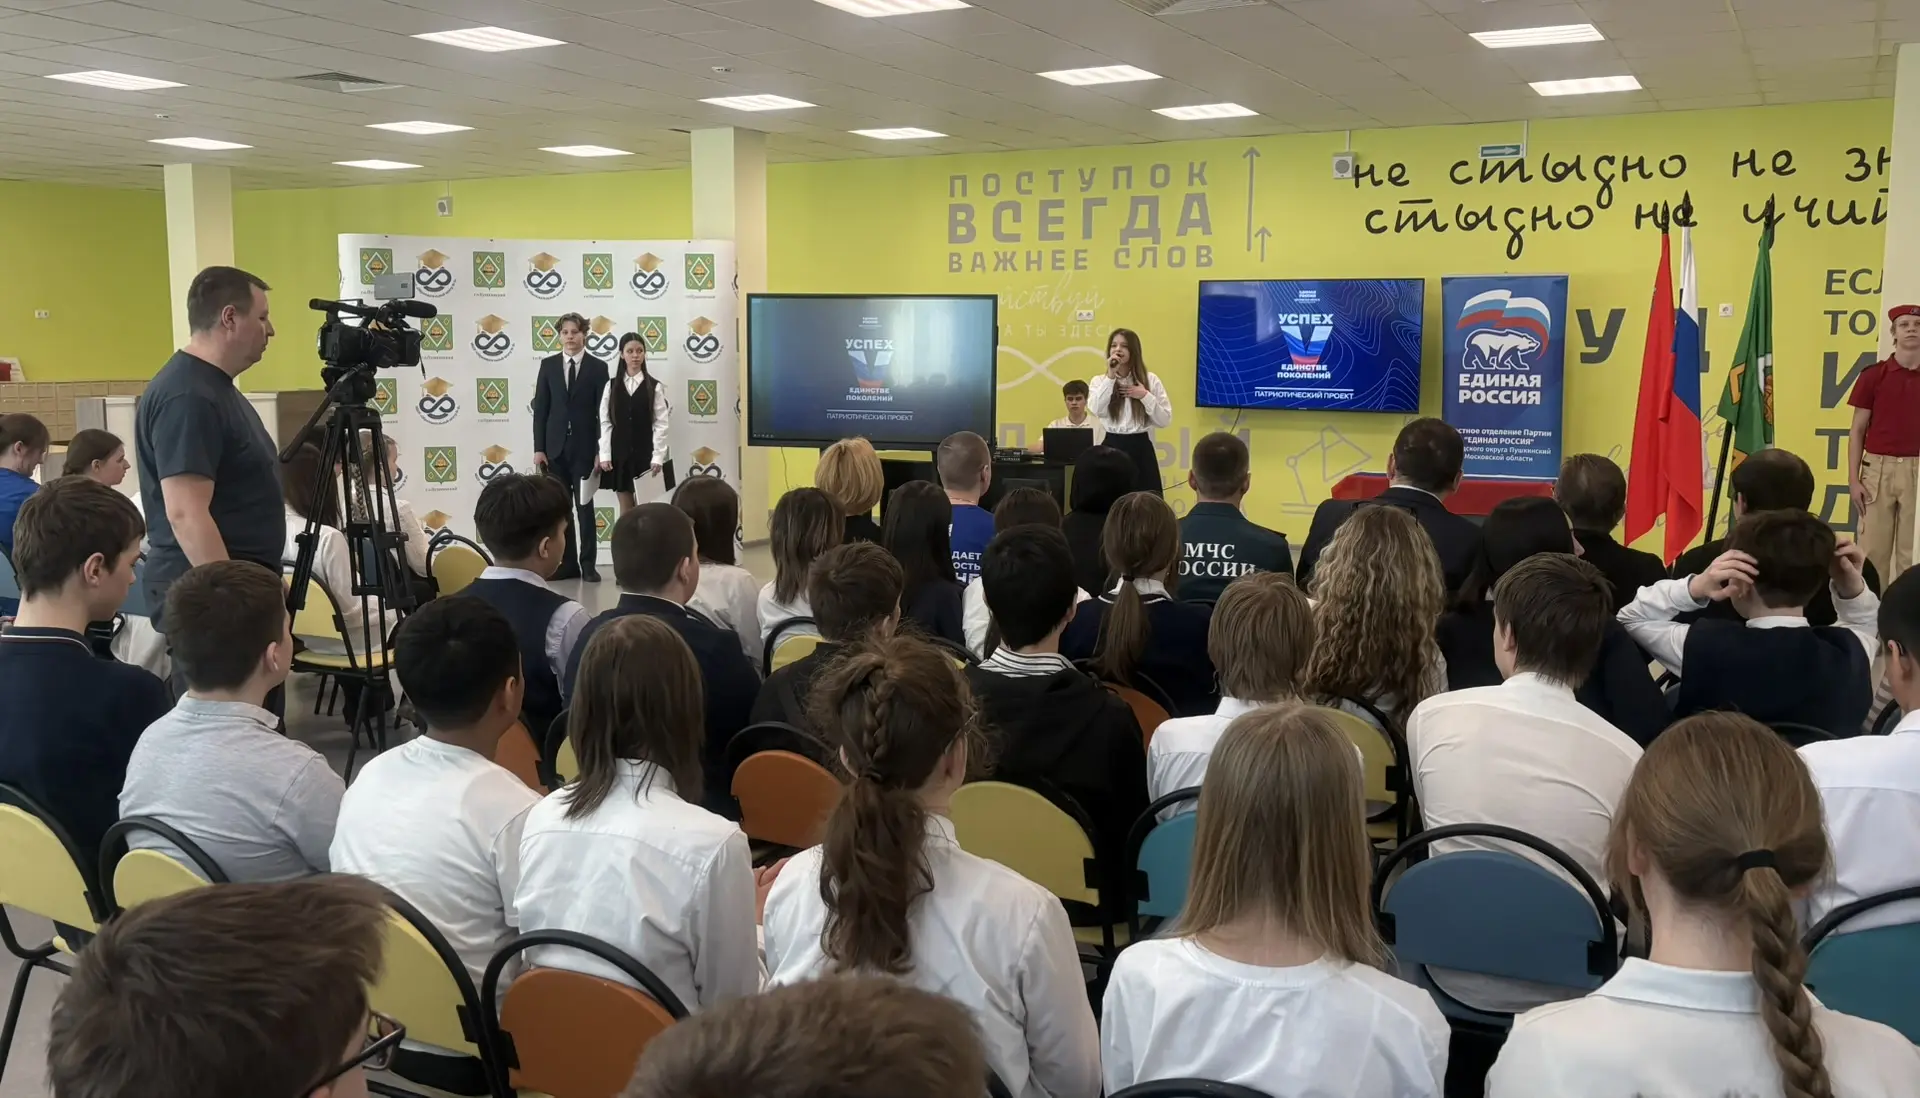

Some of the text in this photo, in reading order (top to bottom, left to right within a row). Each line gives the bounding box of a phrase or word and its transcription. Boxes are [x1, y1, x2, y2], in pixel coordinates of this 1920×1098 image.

[949, 161, 1208, 198] ПОСТУПОК
[1354, 162, 1410, 189] не
[1449, 152, 1688, 210] стыдно
[1732, 148, 1797, 178] не
[948, 192, 1213, 246] ВСЕГДА
[1365, 187, 1888, 260] стыдно не учи
[948, 245, 1214, 273] ВАЖНЕЕ СЛОВ
[1278, 313, 1334, 325] УСПЕХ
[845, 339, 894, 350] УСПЕХ
[1281, 363, 1328, 372] ЕДИНСТВЕ
[1277, 371, 1331, 379] ПОКОЛЕНИЙ
[1459, 373, 1542, 388] ЕДИНАЯ
[845, 394, 893, 402] ПОКОЛЕНИЙ
[1254, 390, 1354, 400] ПАТРИОТИЧЕСКИЙ ПРОЕКТ
[1458, 389, 1541, 405] РОССИЯ
[826, 412, 887, 420] ПАТРИОТИЧЕСКИЙ
[1481, 428, 1522, 436] отделение
[1523, 429, 1552, 438] Партии
[1464, 436, 1535, 445] "ЕДИНАЯ РОССИЯ"
[1485, 446, 1508, 454] округа
[1509, 447, 1552, 455] Пушкинский
[951, 550, 982, 560] ДАЕТ
[1184, 542, 1235, 559] МЧС
[953, 561, 981, 571] ОСТЬ
[1178, 560, 1256, 577] ОССИИ
